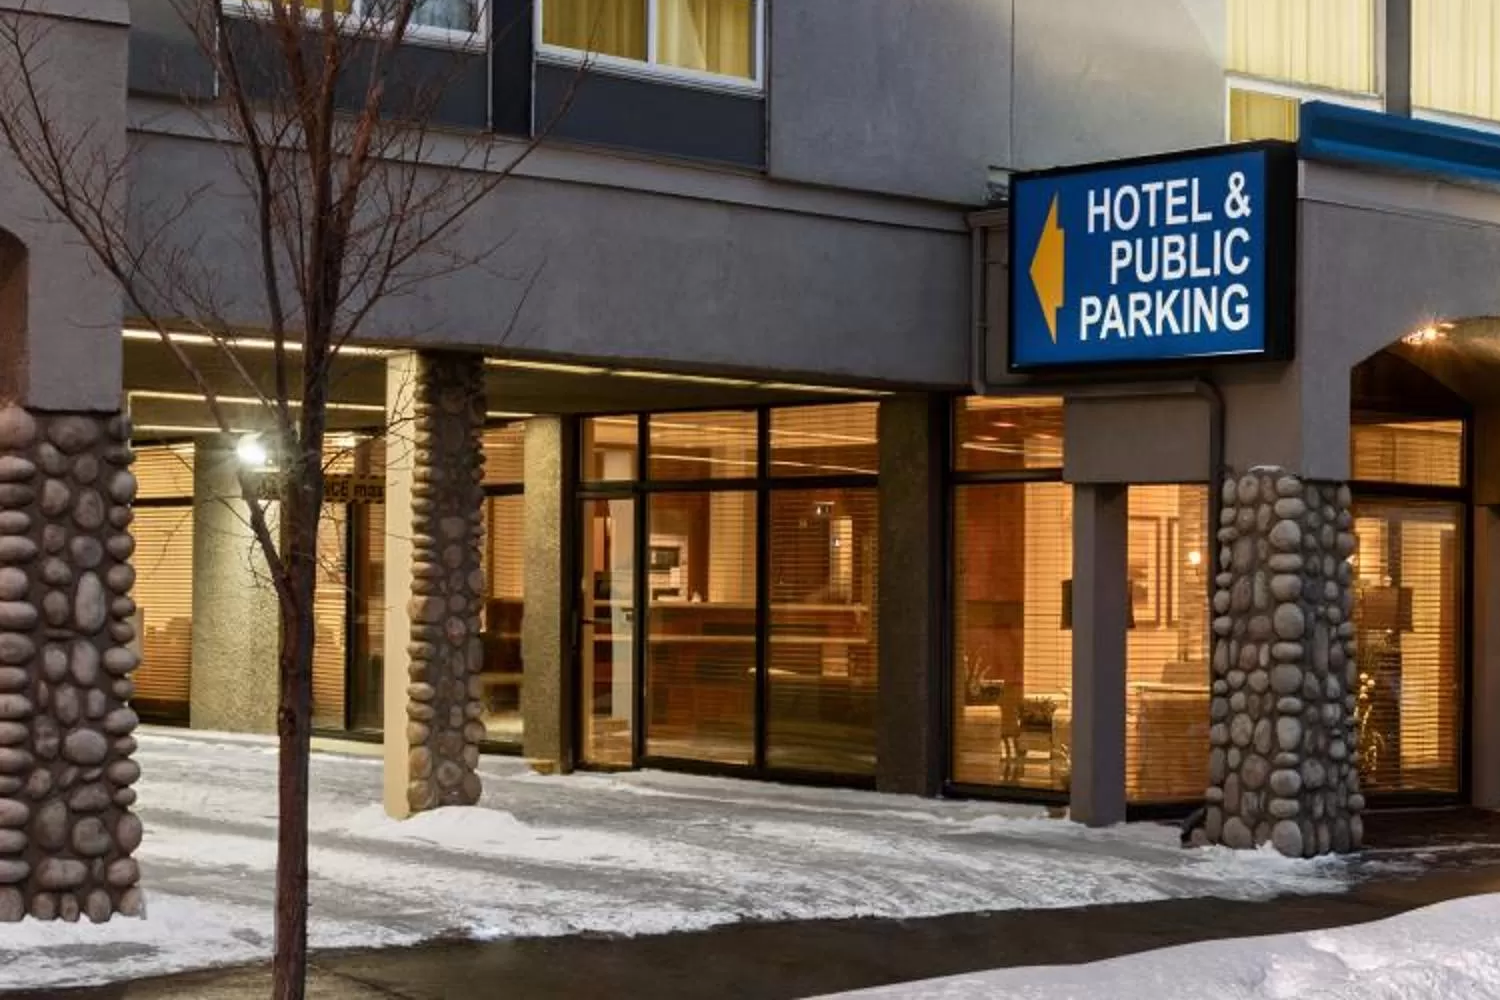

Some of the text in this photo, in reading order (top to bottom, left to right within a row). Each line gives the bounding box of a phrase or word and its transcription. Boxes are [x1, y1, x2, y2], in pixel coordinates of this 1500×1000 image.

[1087, 171, 1251, 234] HOTEL &
[1110, 227, 1251, 285] PUBLIC
[1079, 283, 1250, 341] PARKING
